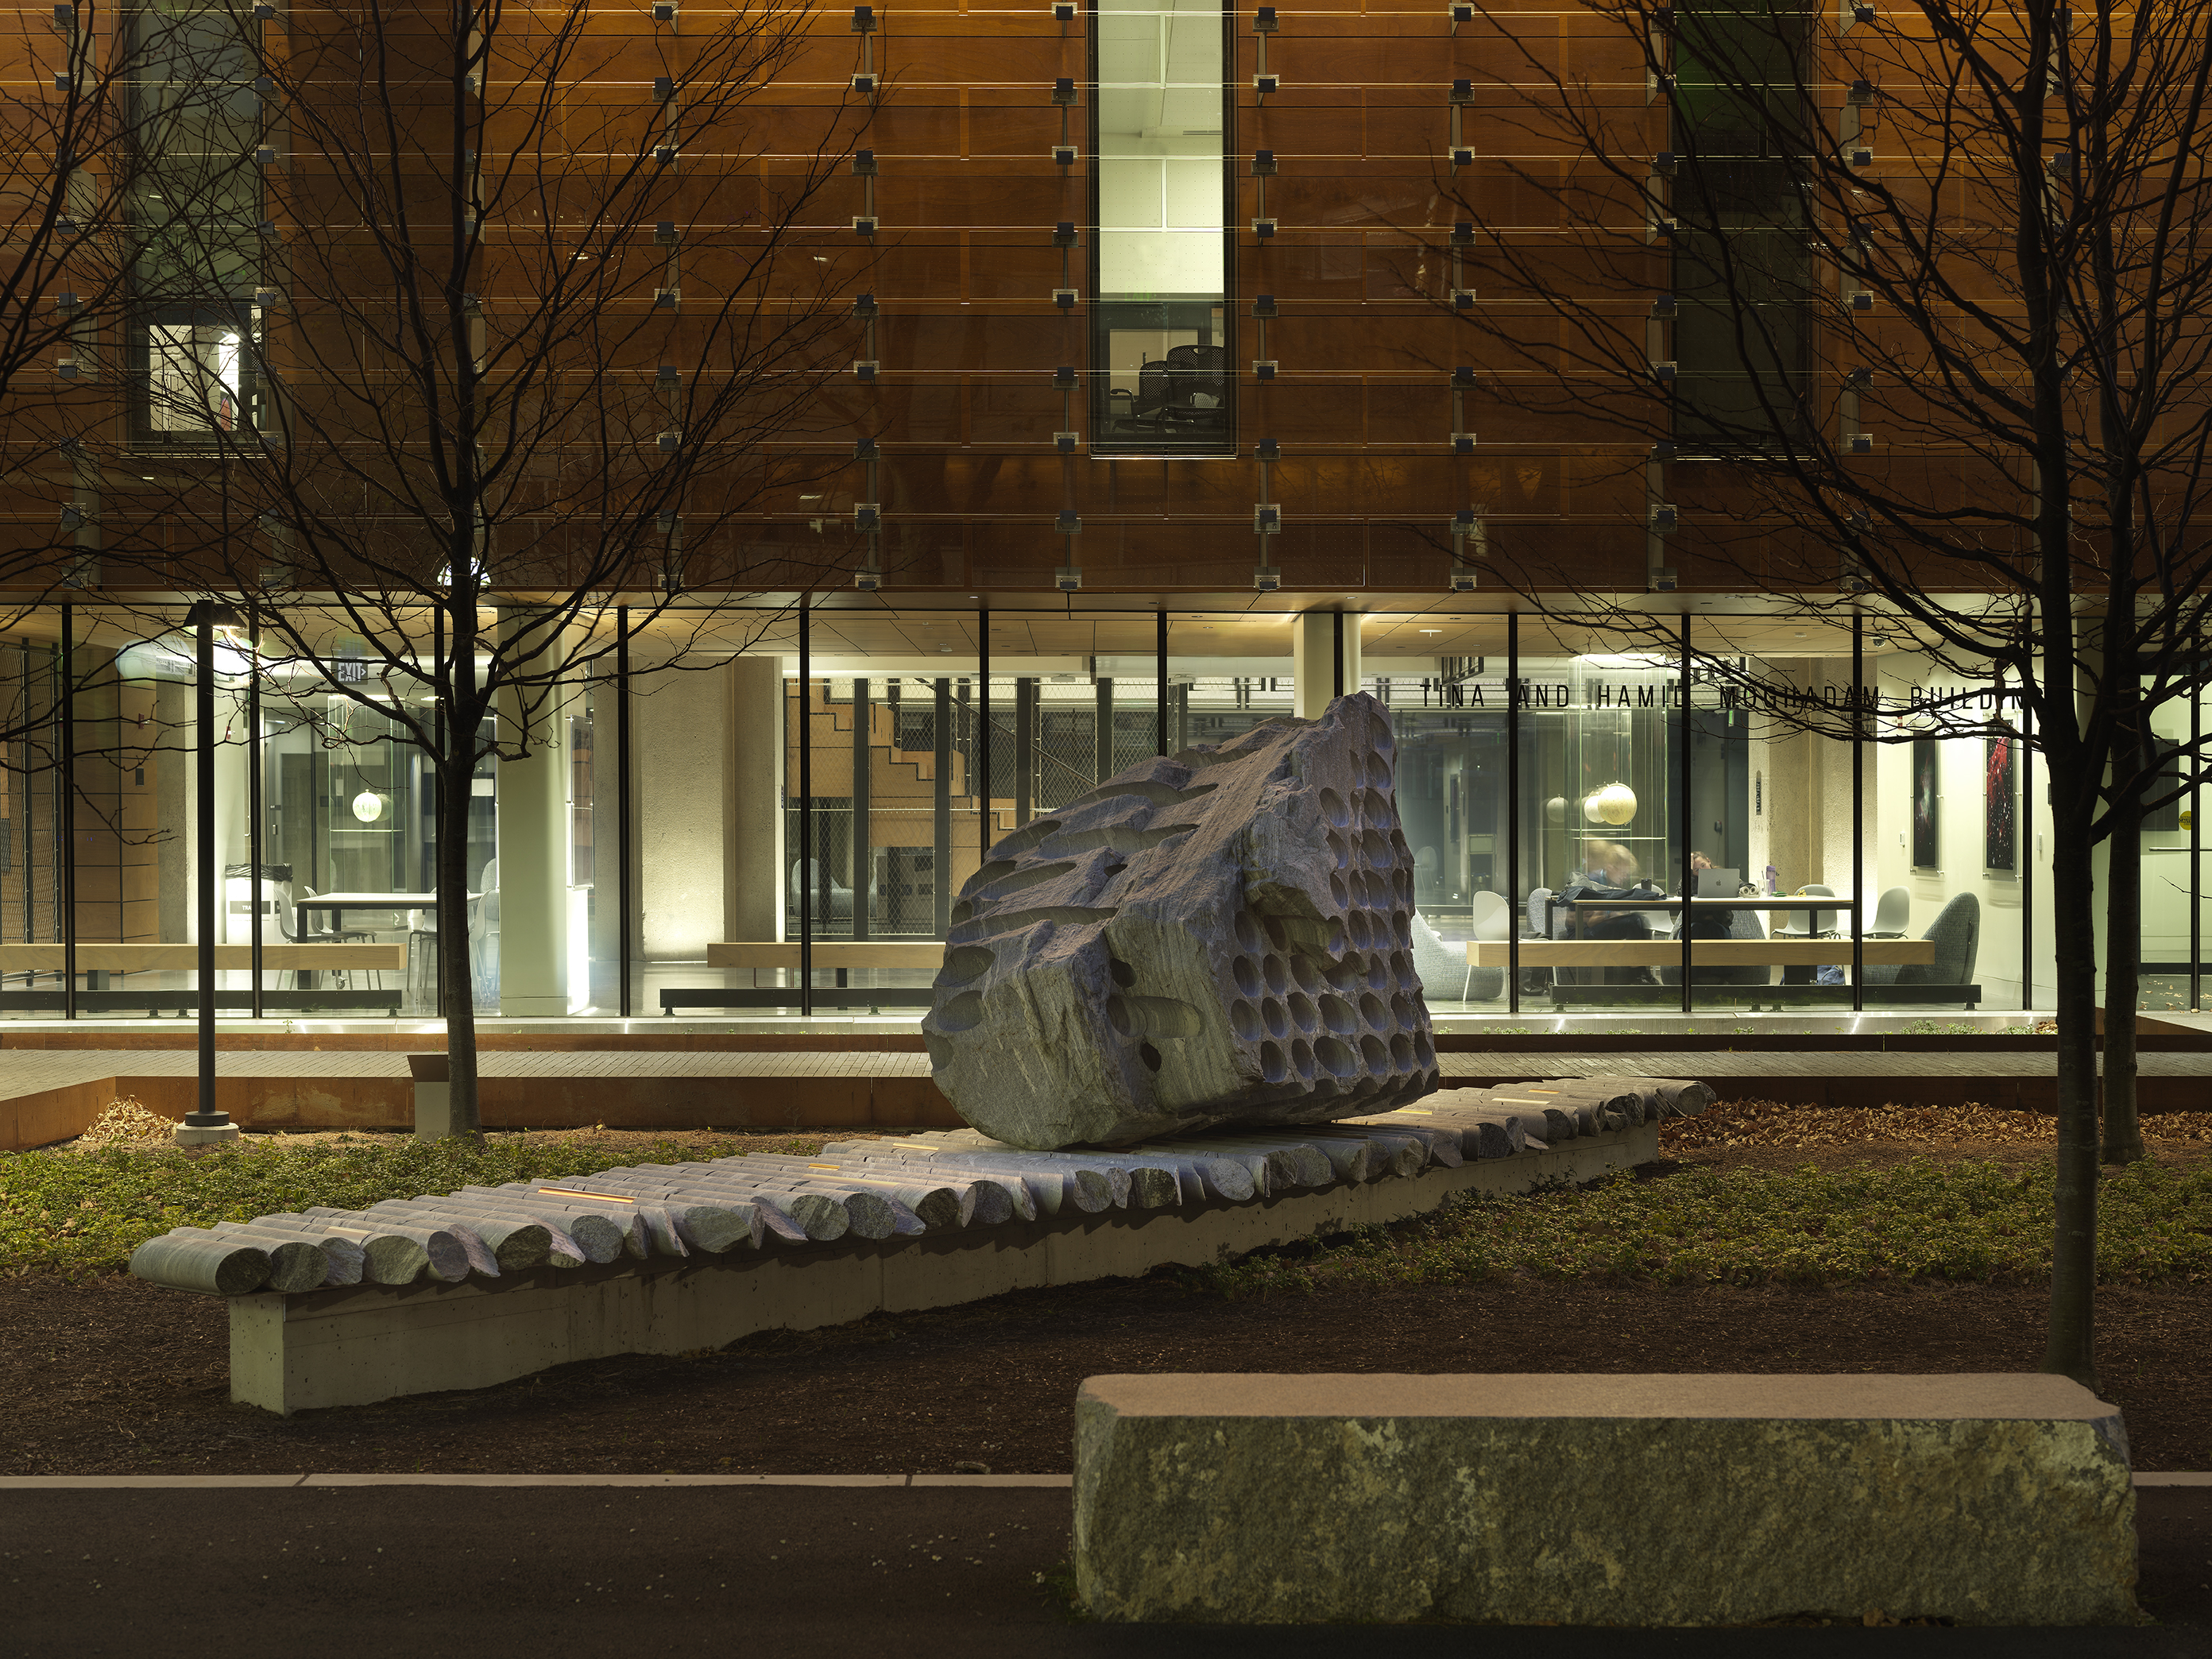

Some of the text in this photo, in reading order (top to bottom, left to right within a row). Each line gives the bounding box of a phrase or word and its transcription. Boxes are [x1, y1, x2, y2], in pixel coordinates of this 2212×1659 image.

[338, 662, 362, 682] EXIT
[1420, 684, 2043, 710] TINA AND HAMID MOGHADAM BUILDN
